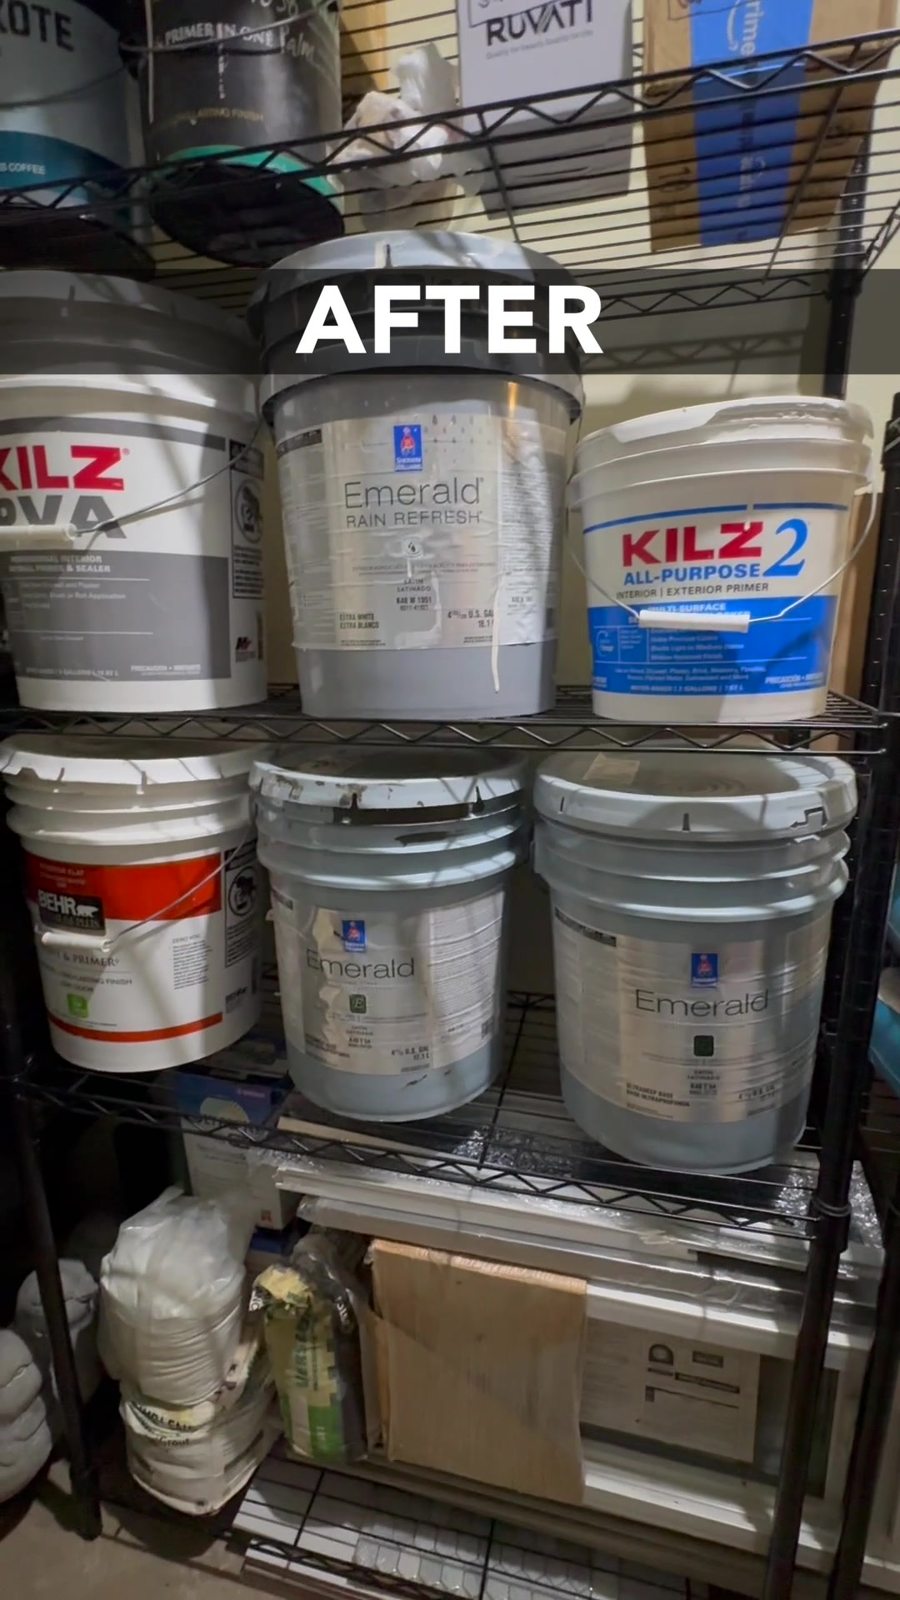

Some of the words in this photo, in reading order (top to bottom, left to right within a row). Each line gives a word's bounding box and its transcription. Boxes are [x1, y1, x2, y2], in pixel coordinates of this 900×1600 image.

[165, 22, 214, 45] PRIMER
[216, 22, 236, 39] IN
[240, 26, 274, 48] ONE
[487, 0, 592, 46] RUVATI
[8, 162, 46, 175] COFFEE
[345, 476, 480, 509] Emerald
[346, 511, 386, 529] RAIN
[394, 509, 480, 526] REFRESH
[622, 520, 764, 567] KILZ
[763, 518, 810, 578] 2
[76, 564, 111, 573] SEALER
[623, 562, 761, 587] ALL-PURPOSE
[616, 588, 657, 600] INTERIOR
[666, 585, 723, 597] EXTERIOR
[726, 582, 769, 593] PRIMER
[38, 889, 77, 916] BEHR
[72, 954, 115, 967] PRIMER
[306, 948, 415, 979] Emerald
[635, 988, 769, 1017] Emerald
